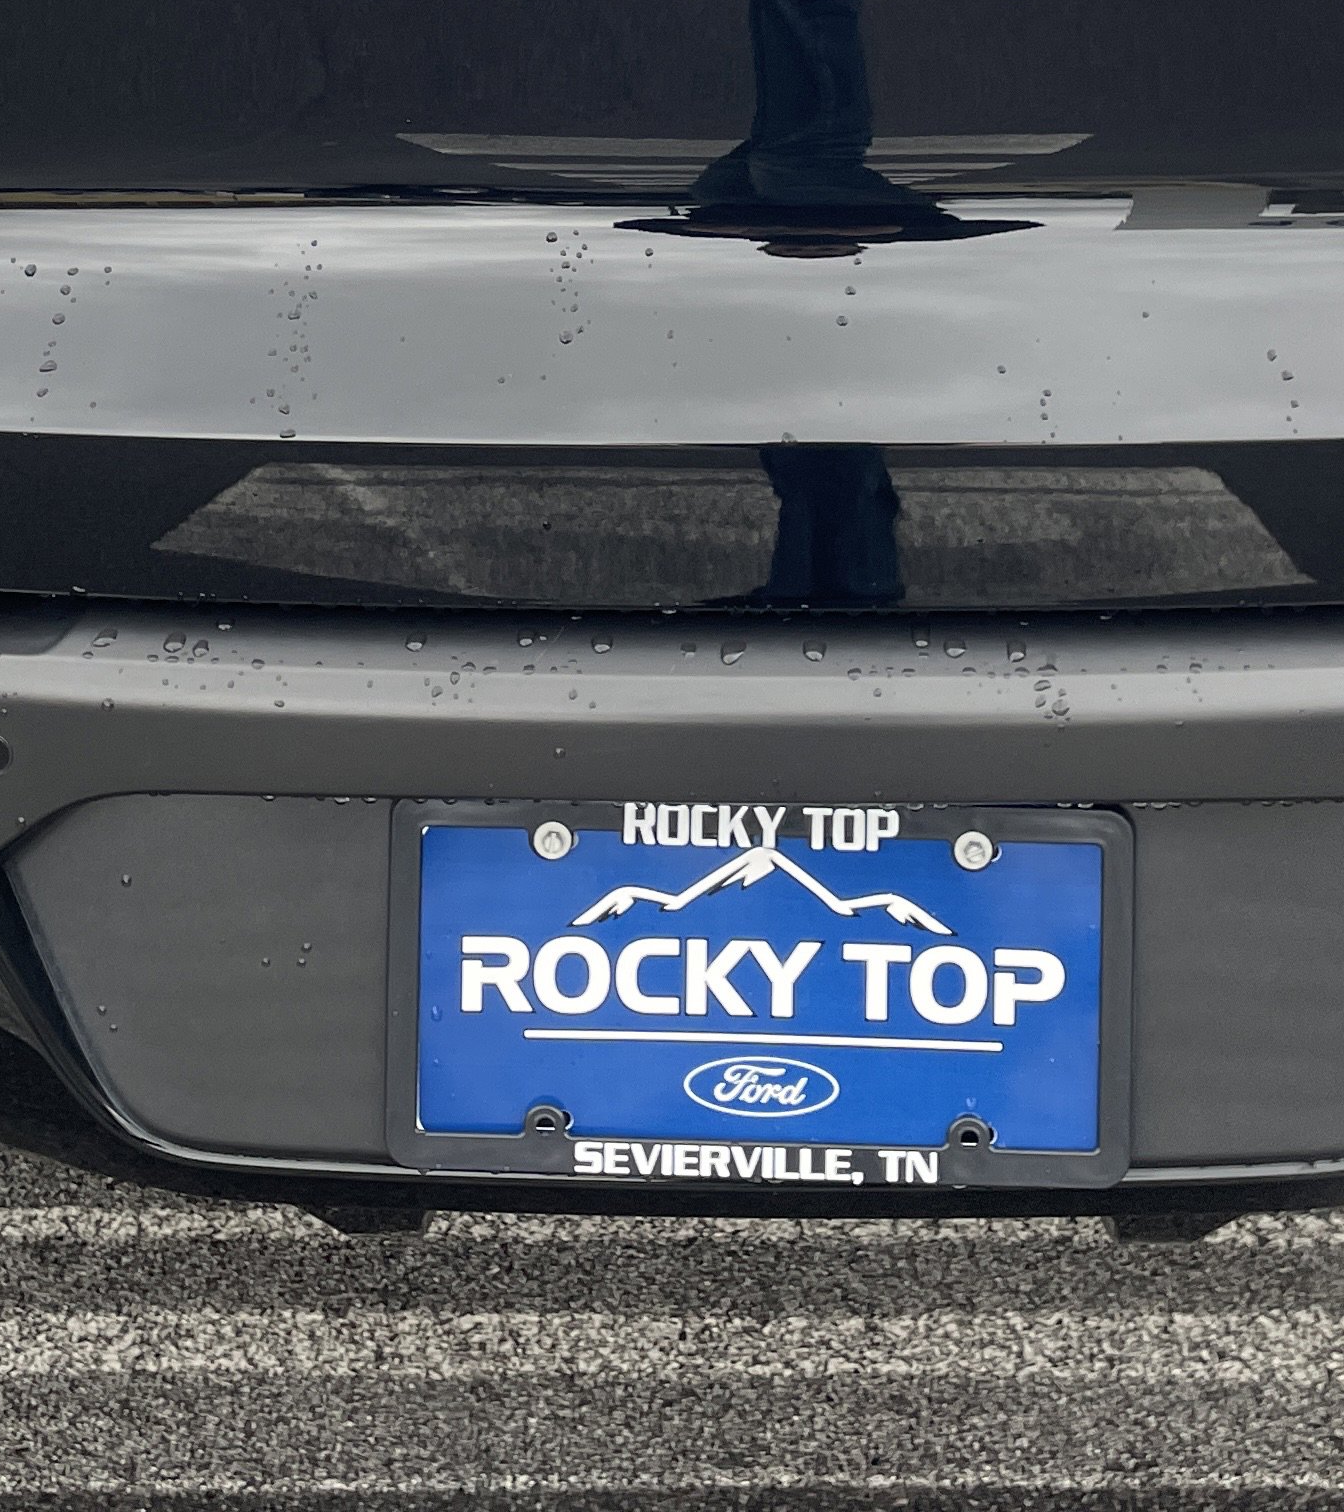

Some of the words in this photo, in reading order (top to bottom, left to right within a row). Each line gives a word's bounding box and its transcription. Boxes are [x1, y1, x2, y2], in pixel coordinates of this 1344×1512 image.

[623, 802, 787, 850] ROCKY
[802, 804, 900, 852] TOP
[460, 935, 822, 1019] ROCKY
[842, 942, 1067, 1026] TOP
[714, 1064, 807, 1107] Ford
[574, 1141, 864, 1186] SEVIERVILLE,
[878, 1150, 939, 1185] TN
